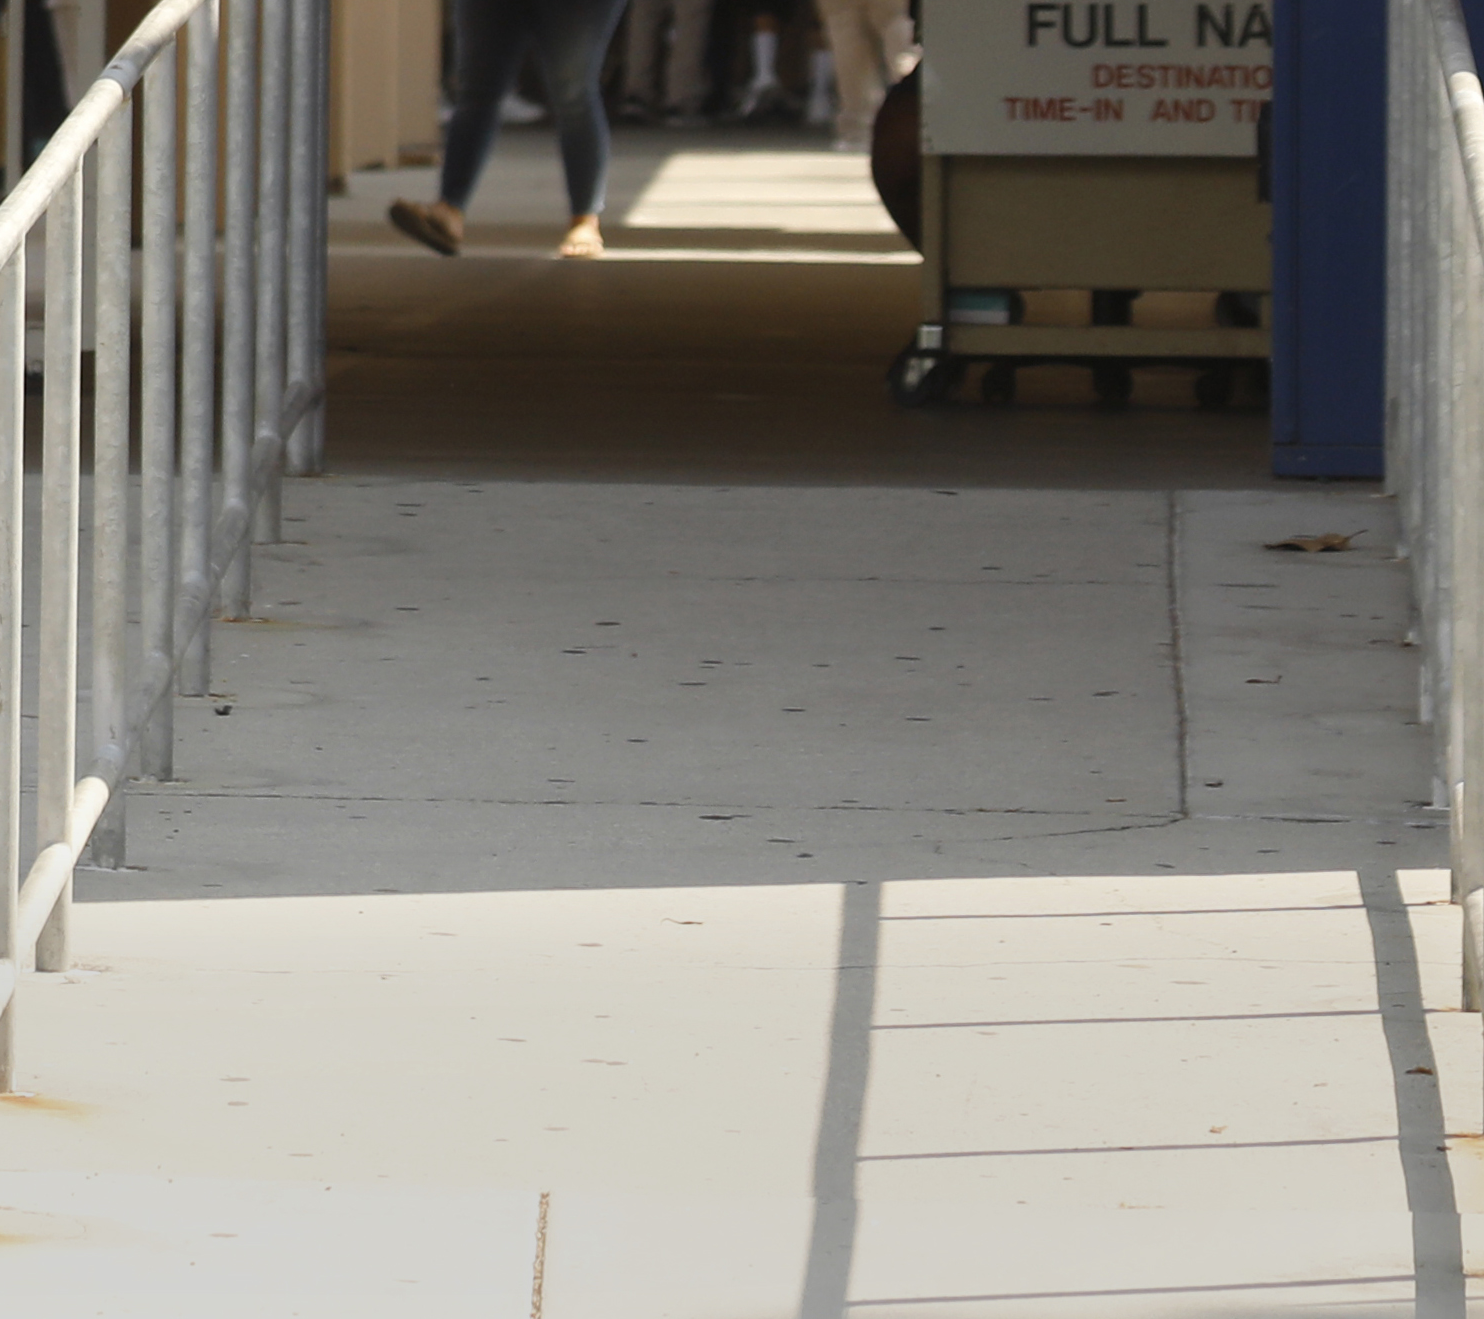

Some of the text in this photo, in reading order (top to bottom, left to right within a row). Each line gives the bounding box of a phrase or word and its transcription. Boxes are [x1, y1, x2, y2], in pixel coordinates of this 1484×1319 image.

[1025, 2, 1169, 49] FULL
[1003, 96, 1124, 123] TIME-IN
[1151, 98, 1216, 123] AND
